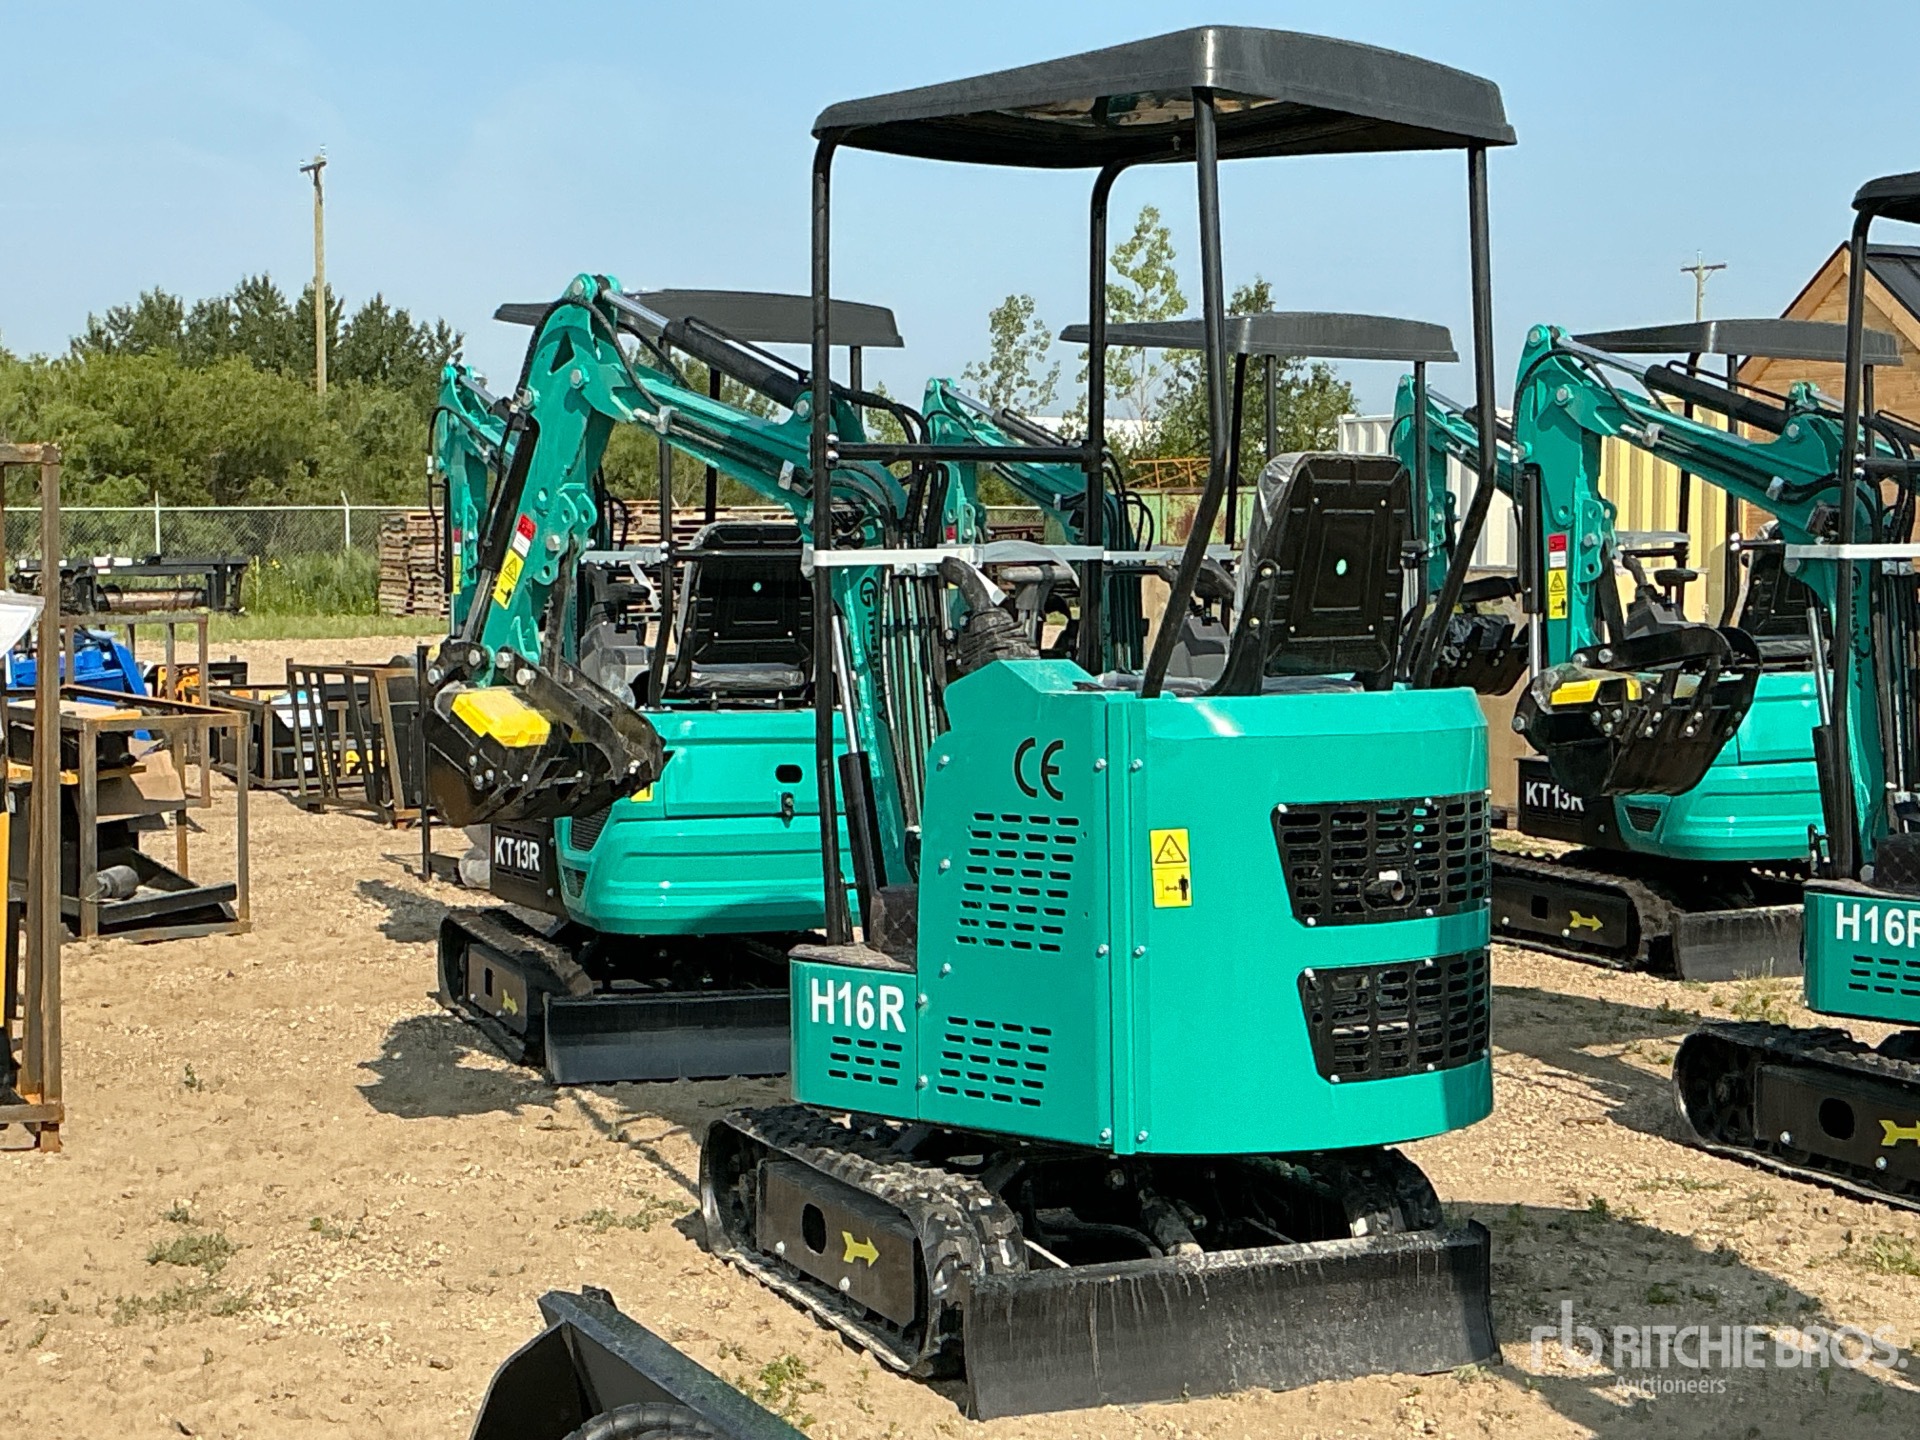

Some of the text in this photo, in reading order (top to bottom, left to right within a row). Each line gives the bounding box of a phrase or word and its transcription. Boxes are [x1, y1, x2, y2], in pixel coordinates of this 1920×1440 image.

[1014, 737, 1064, 801] CE
[495, 836, 540, 871] KT13R
[811, 978, 906, 1033] H16R
